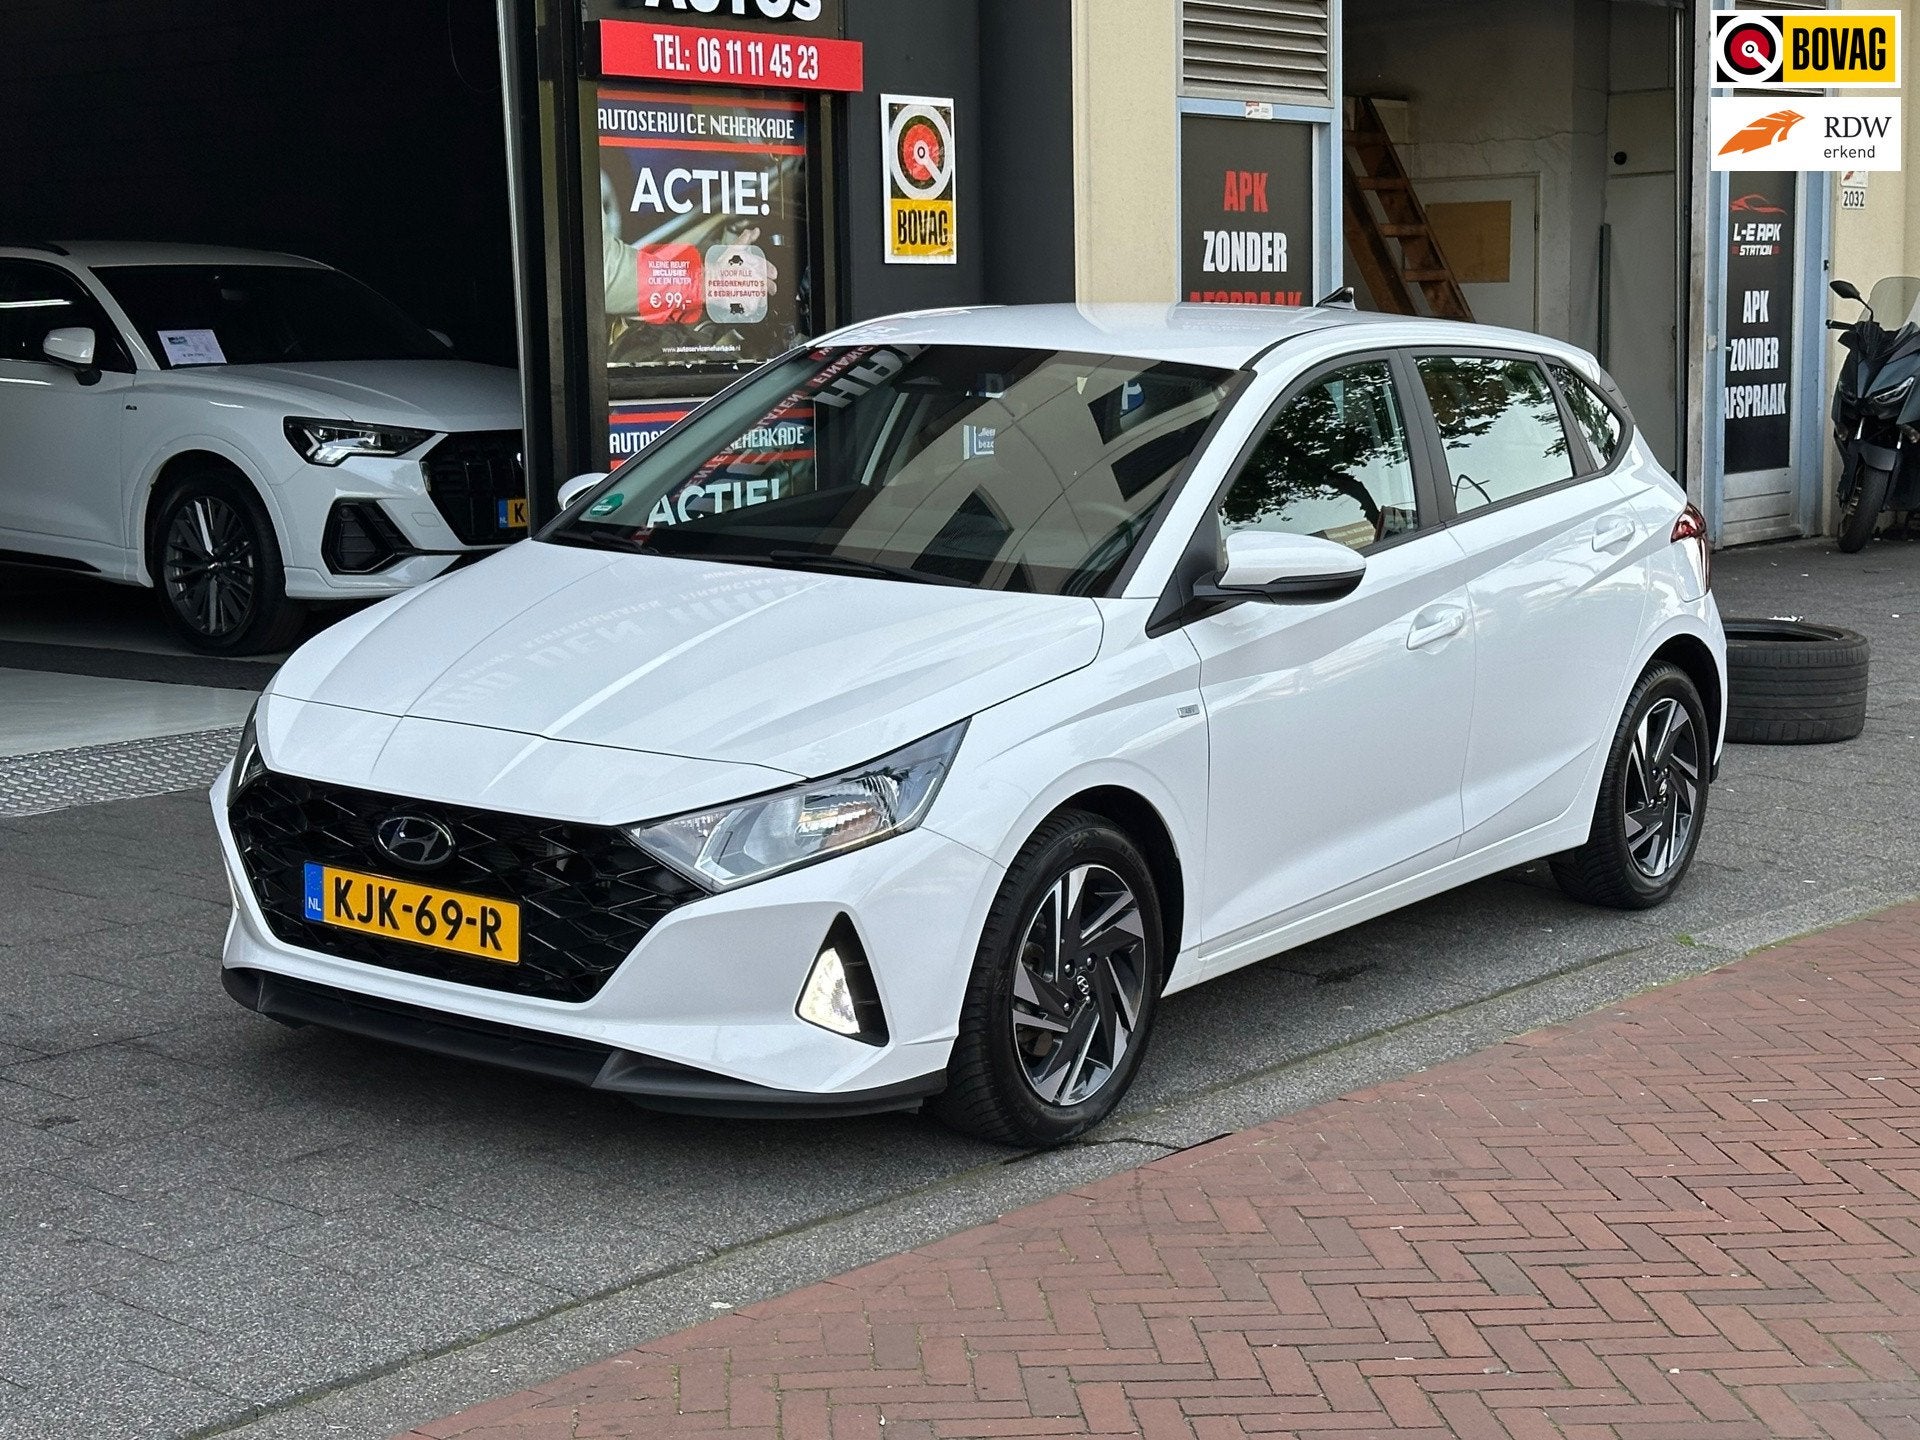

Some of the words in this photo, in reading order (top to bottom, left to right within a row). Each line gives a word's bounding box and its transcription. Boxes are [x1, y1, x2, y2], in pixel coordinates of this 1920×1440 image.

[653, 33, 691, 71] TEL:
[697, 37, 721, 74] 06
[726, 39, 743, 75] 11
[748, 41, 764, 77] 11
[769, 43, 793, 79] 45
[797, 45, 819, 81] 23
[597, 108, 706, 135] AUTOSERVICE
[710, 114, 795, 139] NEHERKADE
[630, 167, 771, 217] ACTIE!
[1223, 169, 1269, 213] APK
[1843, 190, 1865, 207] 2032
[897, 208, 949, 247] BOVAG
[1202, 230, 1288, 273] ZONDER
[1739, 244, 1773, 256] STATION
[650, 292, 662, 309] €
[665, 292, 692, 310] 99,-
[1743, 290, 1769, 323] APK
[1730, 337, 1780, 371] ZONDER
[1725, 383, 1787, 419] AFSPRAAK
[308, 897, 322, 912] NL
[334, 876, 503, 952] KJK-69-R
